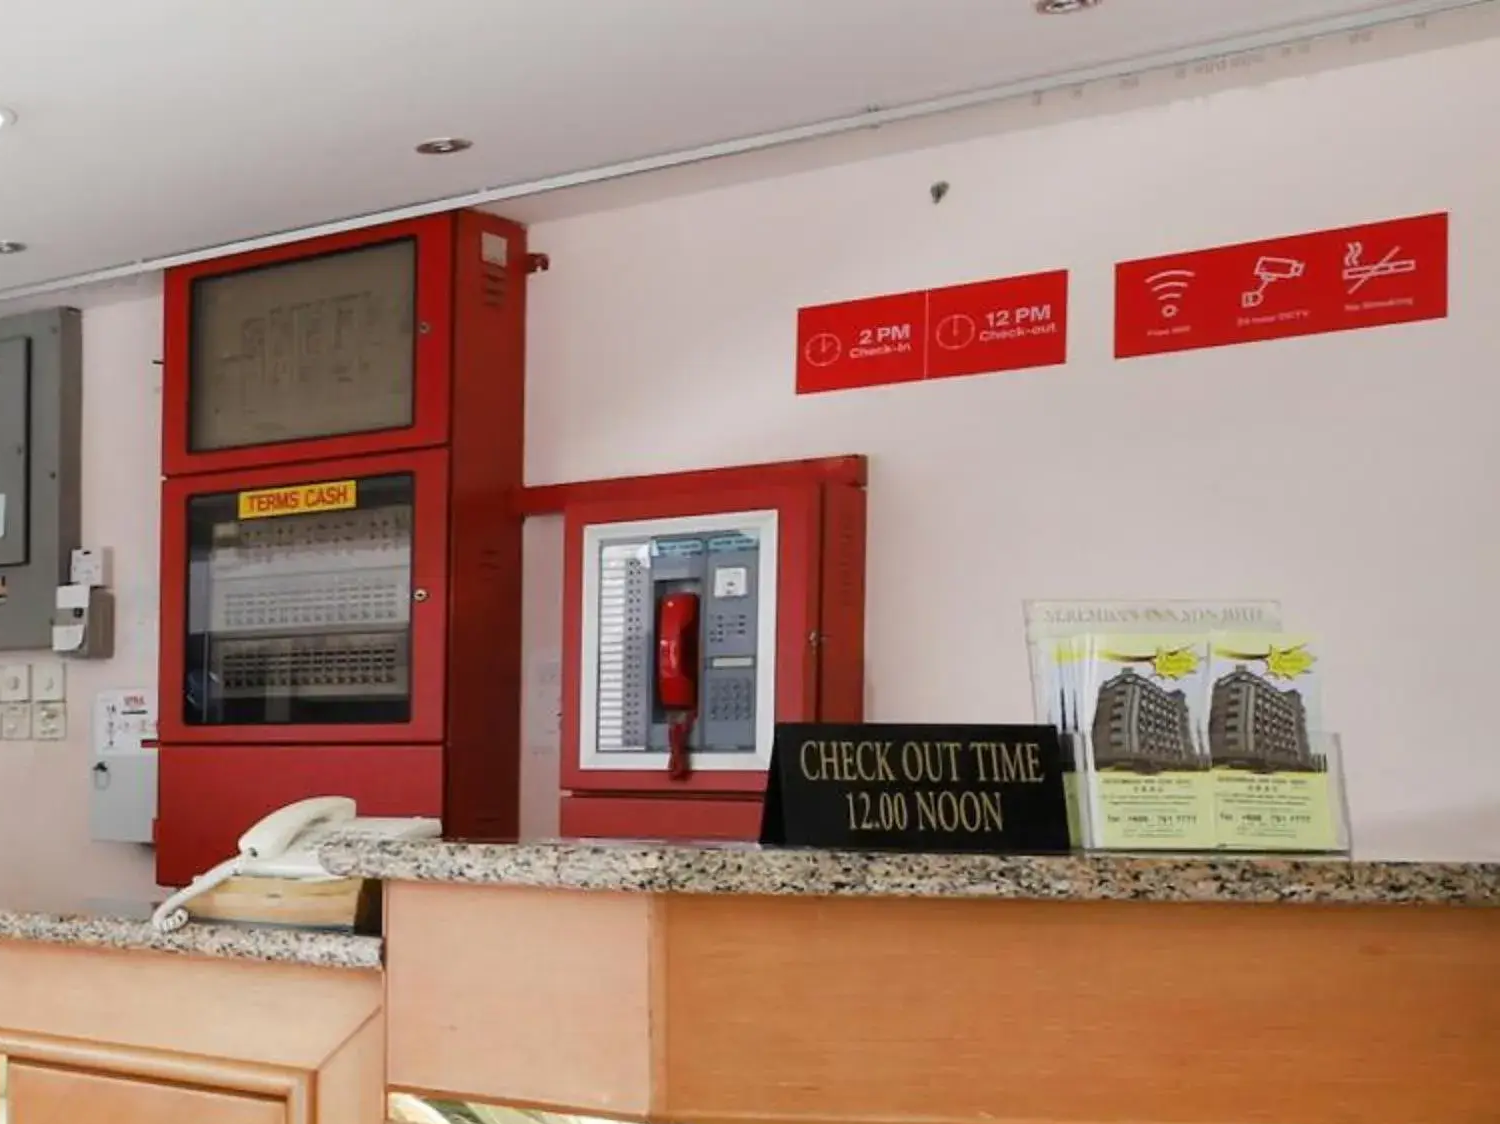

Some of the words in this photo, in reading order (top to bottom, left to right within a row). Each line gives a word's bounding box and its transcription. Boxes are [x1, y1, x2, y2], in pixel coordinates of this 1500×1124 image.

[986, 311, 1010, 328] 12
[1015, 304, 1051, 324] PM
[859, 329, 871, 345] 2
[876, 324, 911, 343] PM
[979, 323, 1058, 342] Check-out
[850, 342, 912, 359] Check-in
[248, 491, 300, 513] TERMS
[307, 485, 351, 508] CASH
[800, 740, 896, 781] CHECK
[902, 741, 962, 783] OUT
[969, 742, 1045, 783] TIME
[846, 791, 908, 831] 12.00
[915, 791, 1003, 832] NOON
